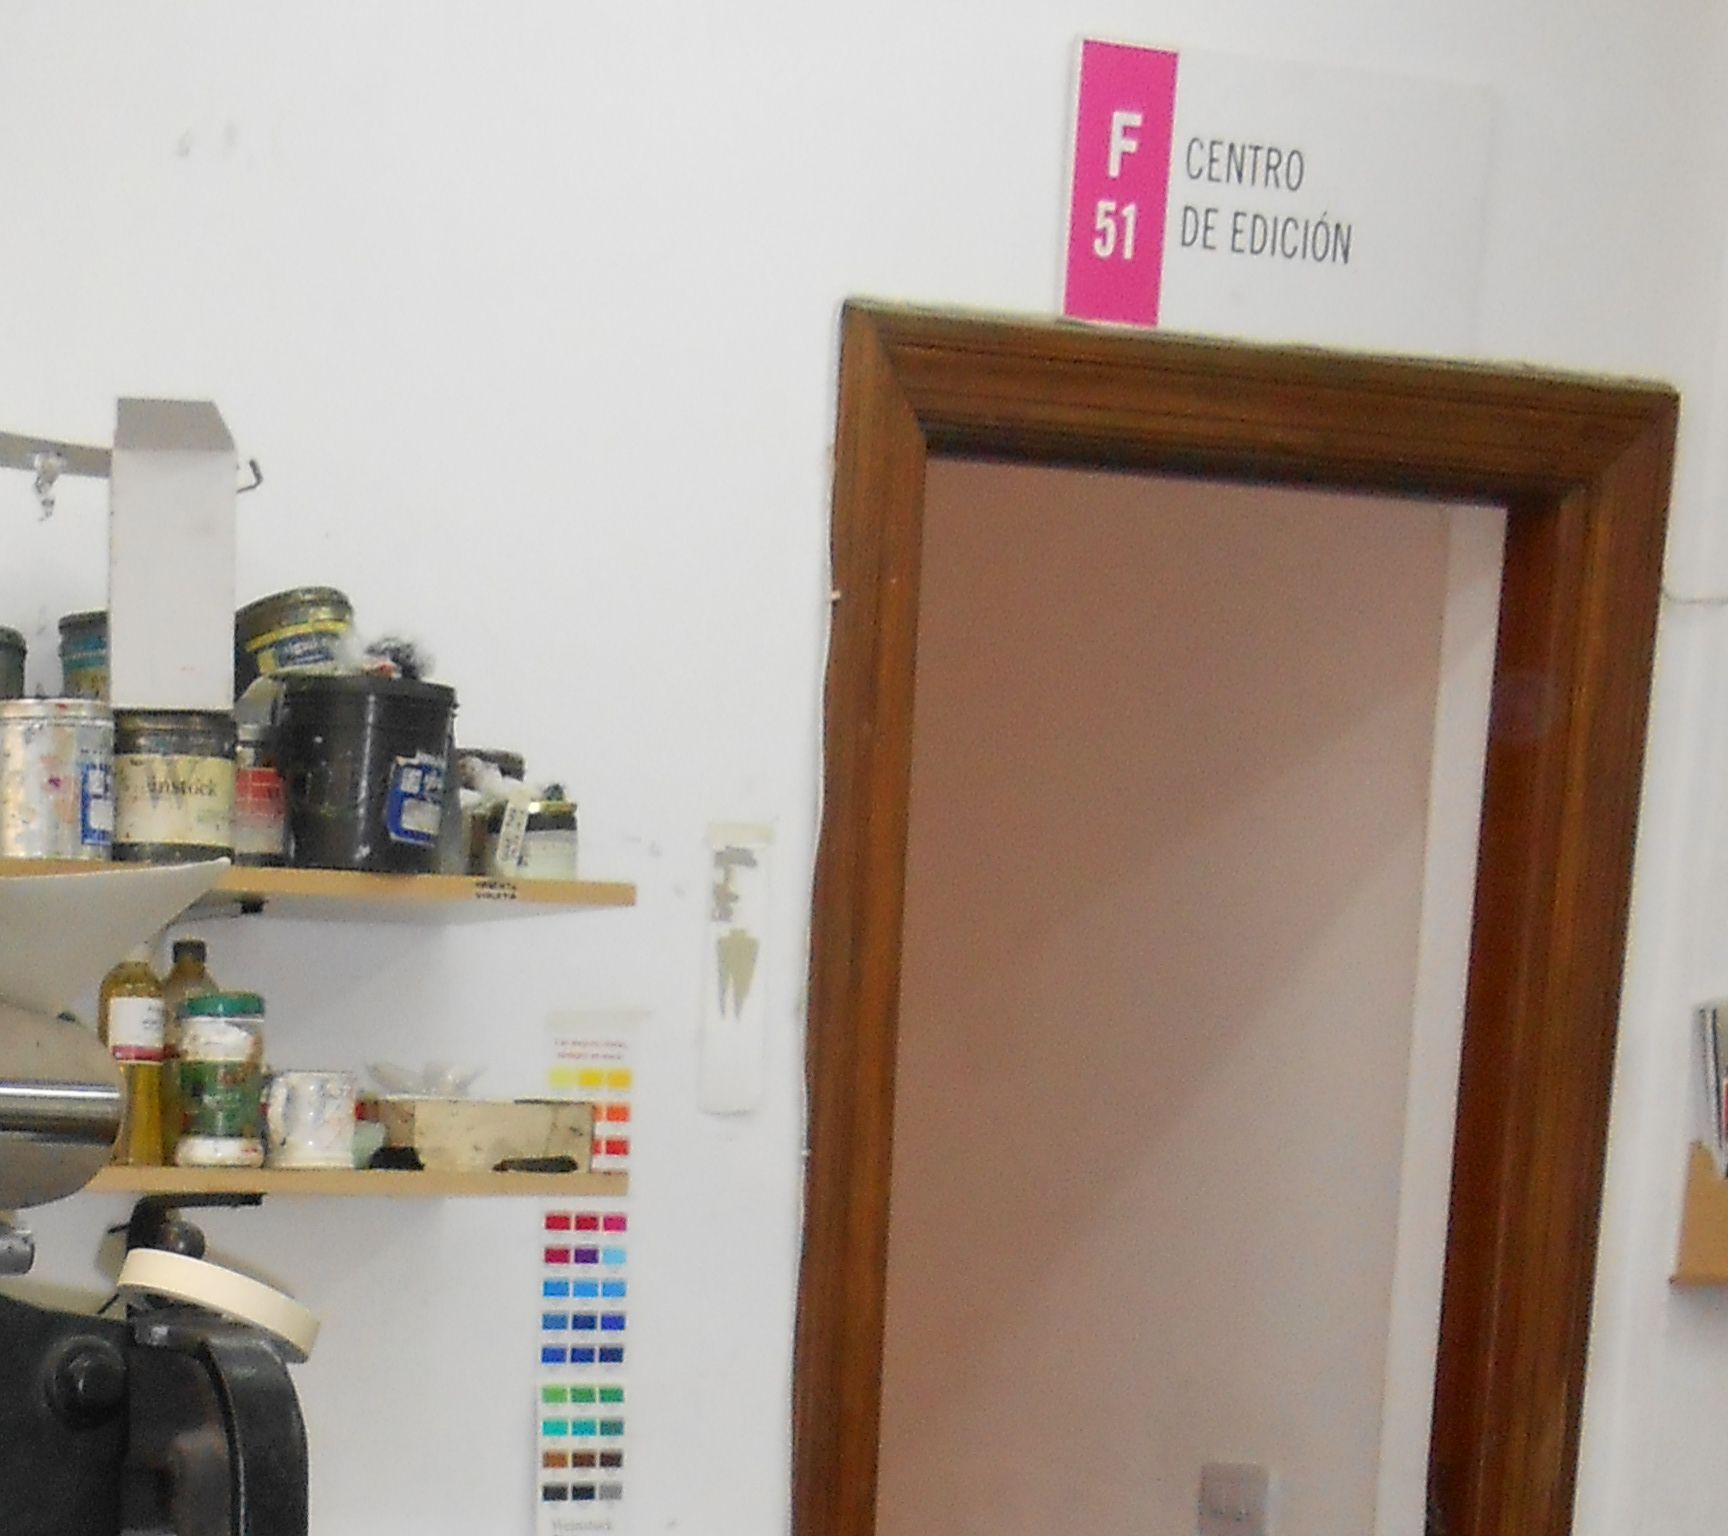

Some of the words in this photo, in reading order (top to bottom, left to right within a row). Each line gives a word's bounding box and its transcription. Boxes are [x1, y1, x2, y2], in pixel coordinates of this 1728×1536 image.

[1106, 110, 1143, 179] F
[1184, 136, 1305, 193] CENTRO
[1092, 199, 1138, 262] 51
[1180, 205, 1219, 251] DE
[1230, 210, 1352, 265] EDICIÓN
